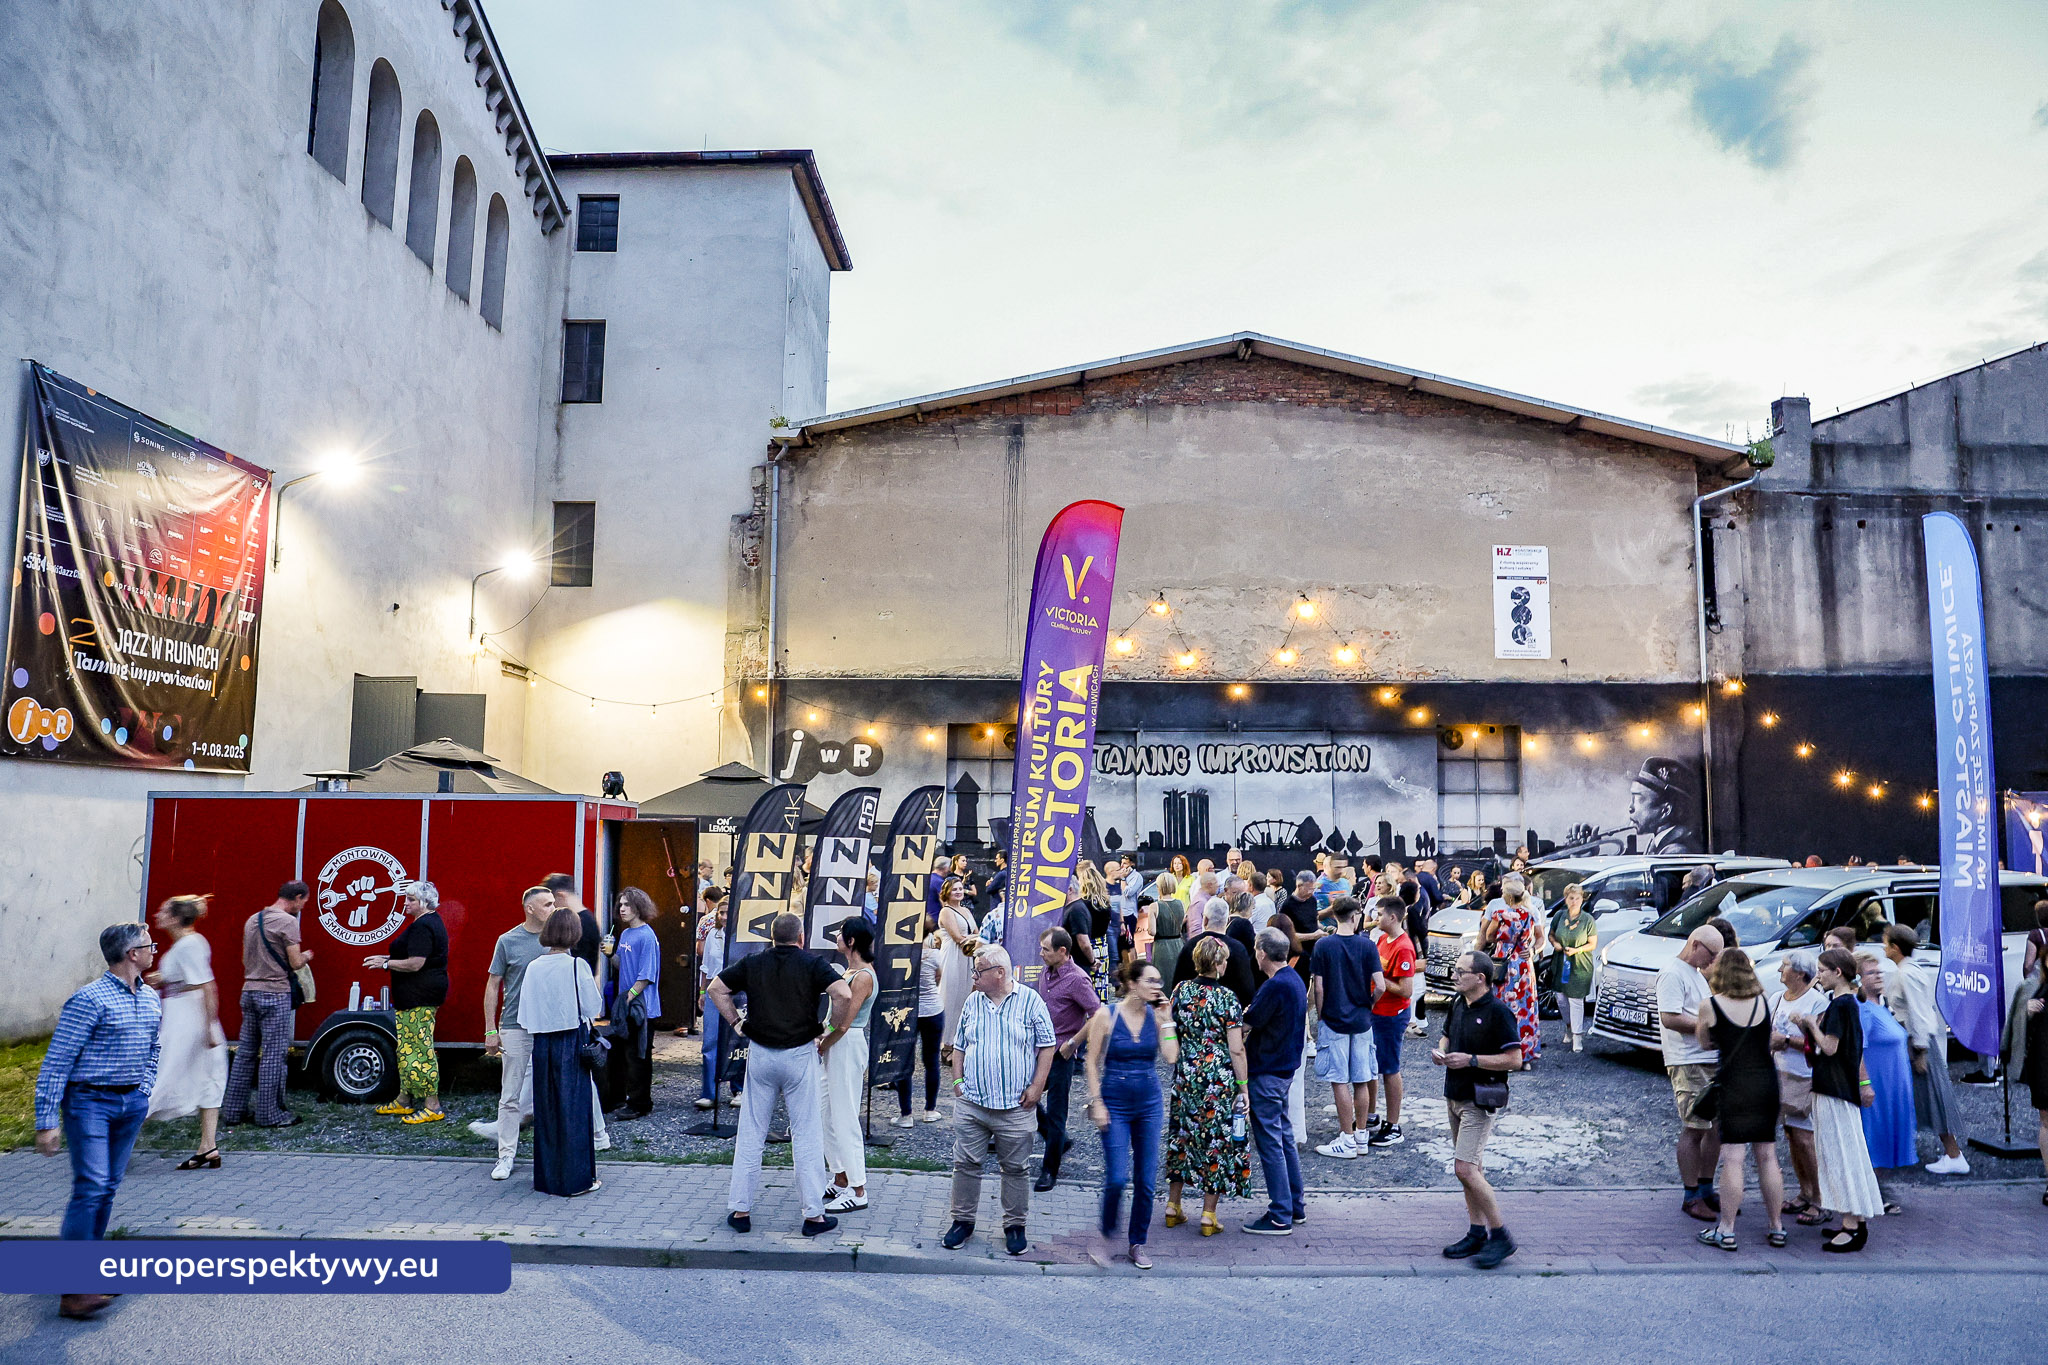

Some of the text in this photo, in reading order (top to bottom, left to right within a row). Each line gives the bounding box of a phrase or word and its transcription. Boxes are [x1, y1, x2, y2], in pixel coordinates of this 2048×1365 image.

[141, 436, 165, 452] SONING
[1045, 606, 1100, 629] VICTORIA
[114, 627, 149, 658] JAZZ
[151, 634, 163, 660] W
[165, 638, 219, 671] RUINACH
[1091, 664, 1100, 716] GLIWICACH
[192, 741, 245, 760] 1-9.08.2025
[1094, 742, 1371, 776] TAMING IMPROVISATION
[1014, 661, 1055, 918] CENTRUM KULTURY
[1031, 663, 1094, 919] VICTORIA
[858, 795, 878, 834] HD
[332, 849, 394, 869] MONTOWNIA
[1007, 805, 1022, 920] NA WYDARZENIE ZAPRASZA
[888, 834, 934, 981] JAZZ
[324, 918, 399, 942] SMAKU I ZDROWIA
